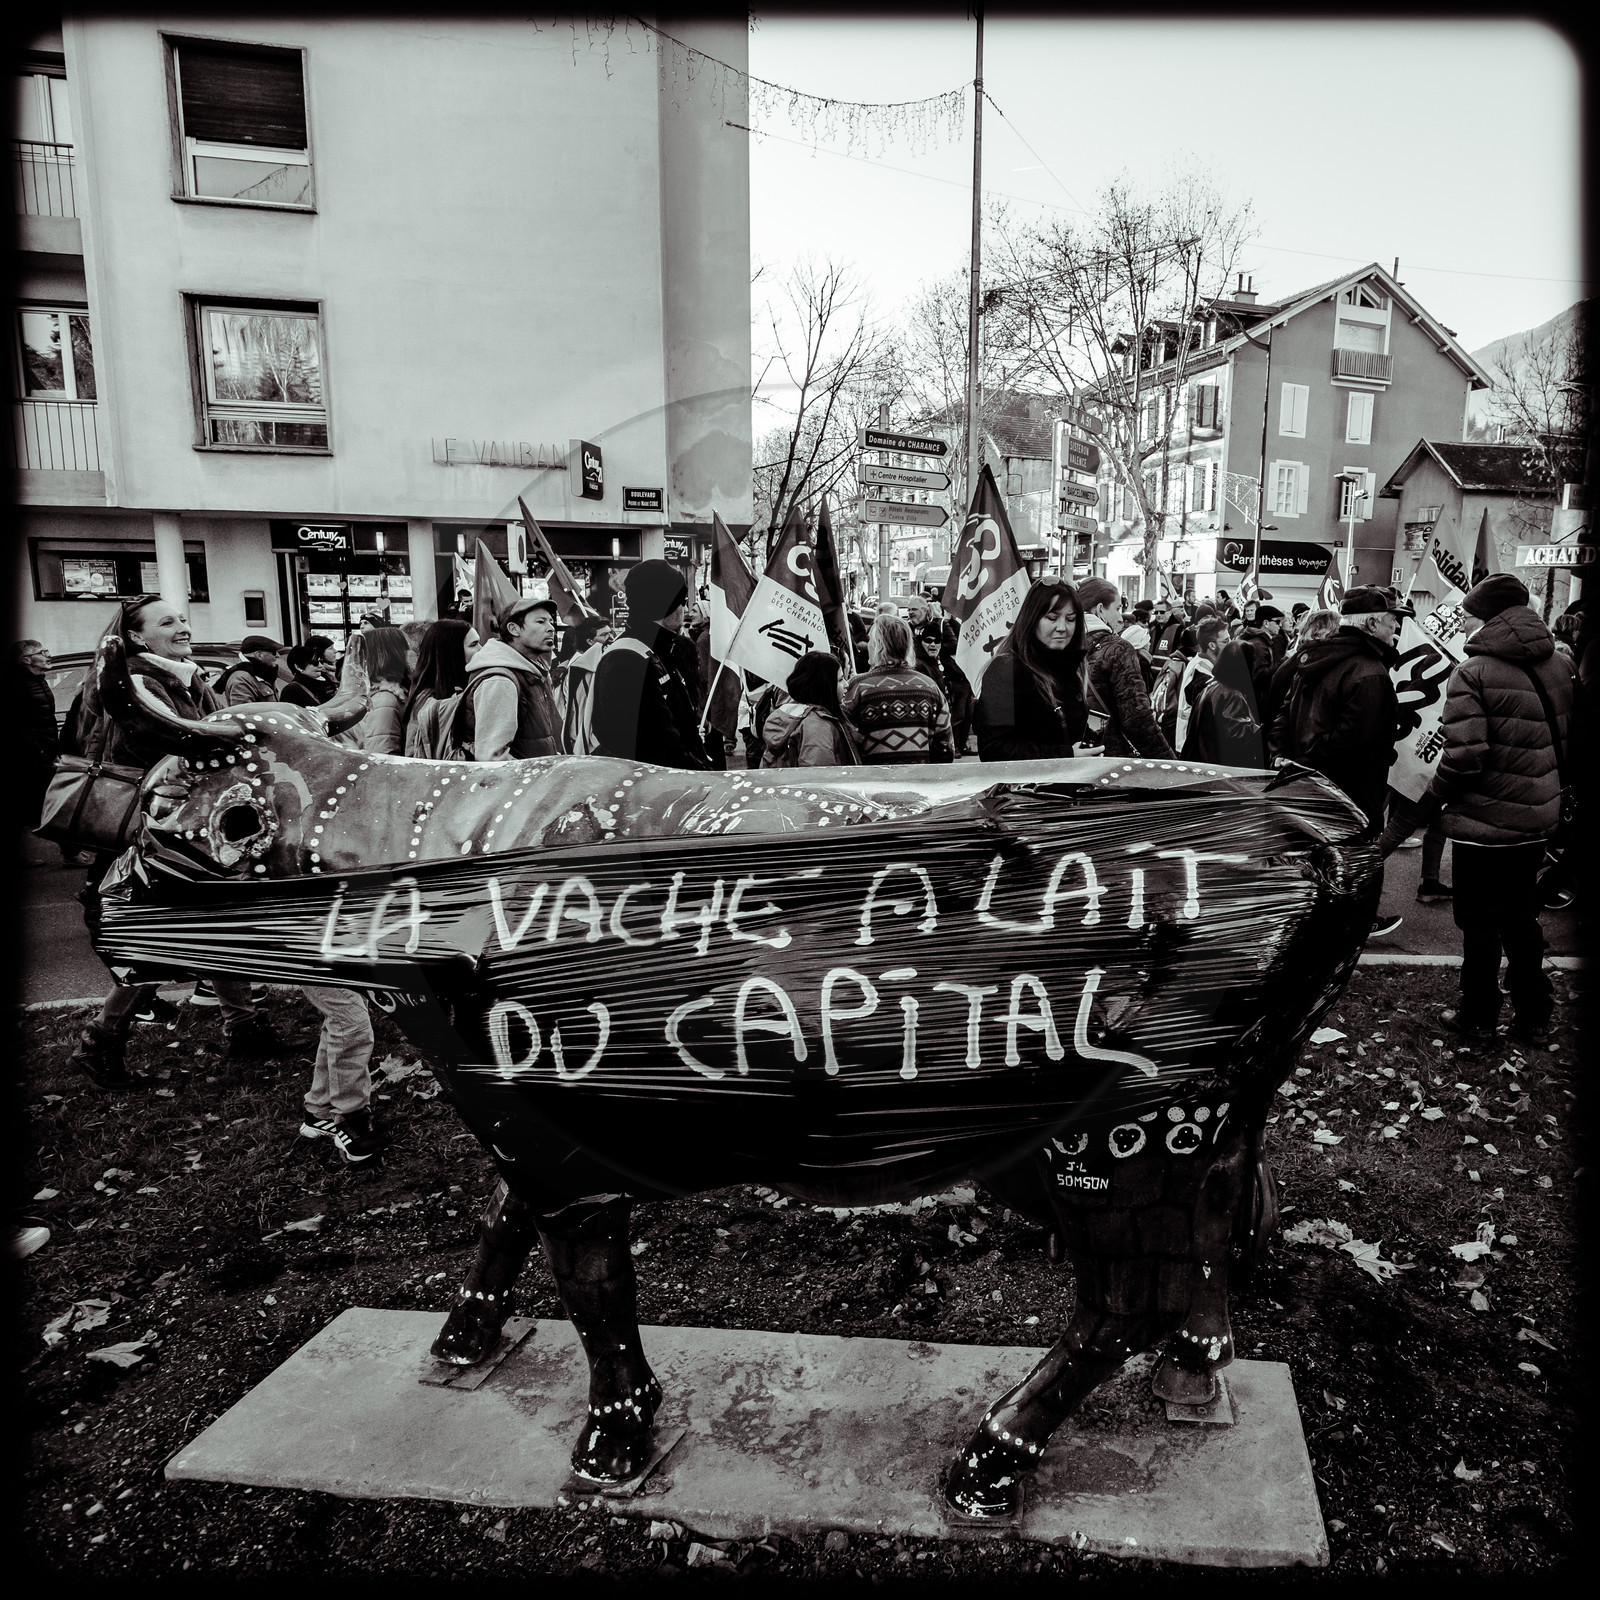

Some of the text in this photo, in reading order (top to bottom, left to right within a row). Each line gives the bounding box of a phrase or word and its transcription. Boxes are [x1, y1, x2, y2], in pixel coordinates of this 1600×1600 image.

[868, 435, 941, 452] Domaine de CHARANCE
[431, 437, 567, 468] LE VAUBAN
[877, 471, 928, 484] Centre Hospitalier
[630, 491, 657, 499] BOULEVARD
[297, 527, 339, 541] Century
[334, 536, 347, 549] 21
[1523, 547, 1580, 565] ACHAT
[770, 597, 784, 609] DES
[320, 876, 432, 962] LA
[487, 868, 824, 956] VACHE
[488, 1000, 611, 1080] DU
[1056, 1173, 1110, 1190] SOMSON
